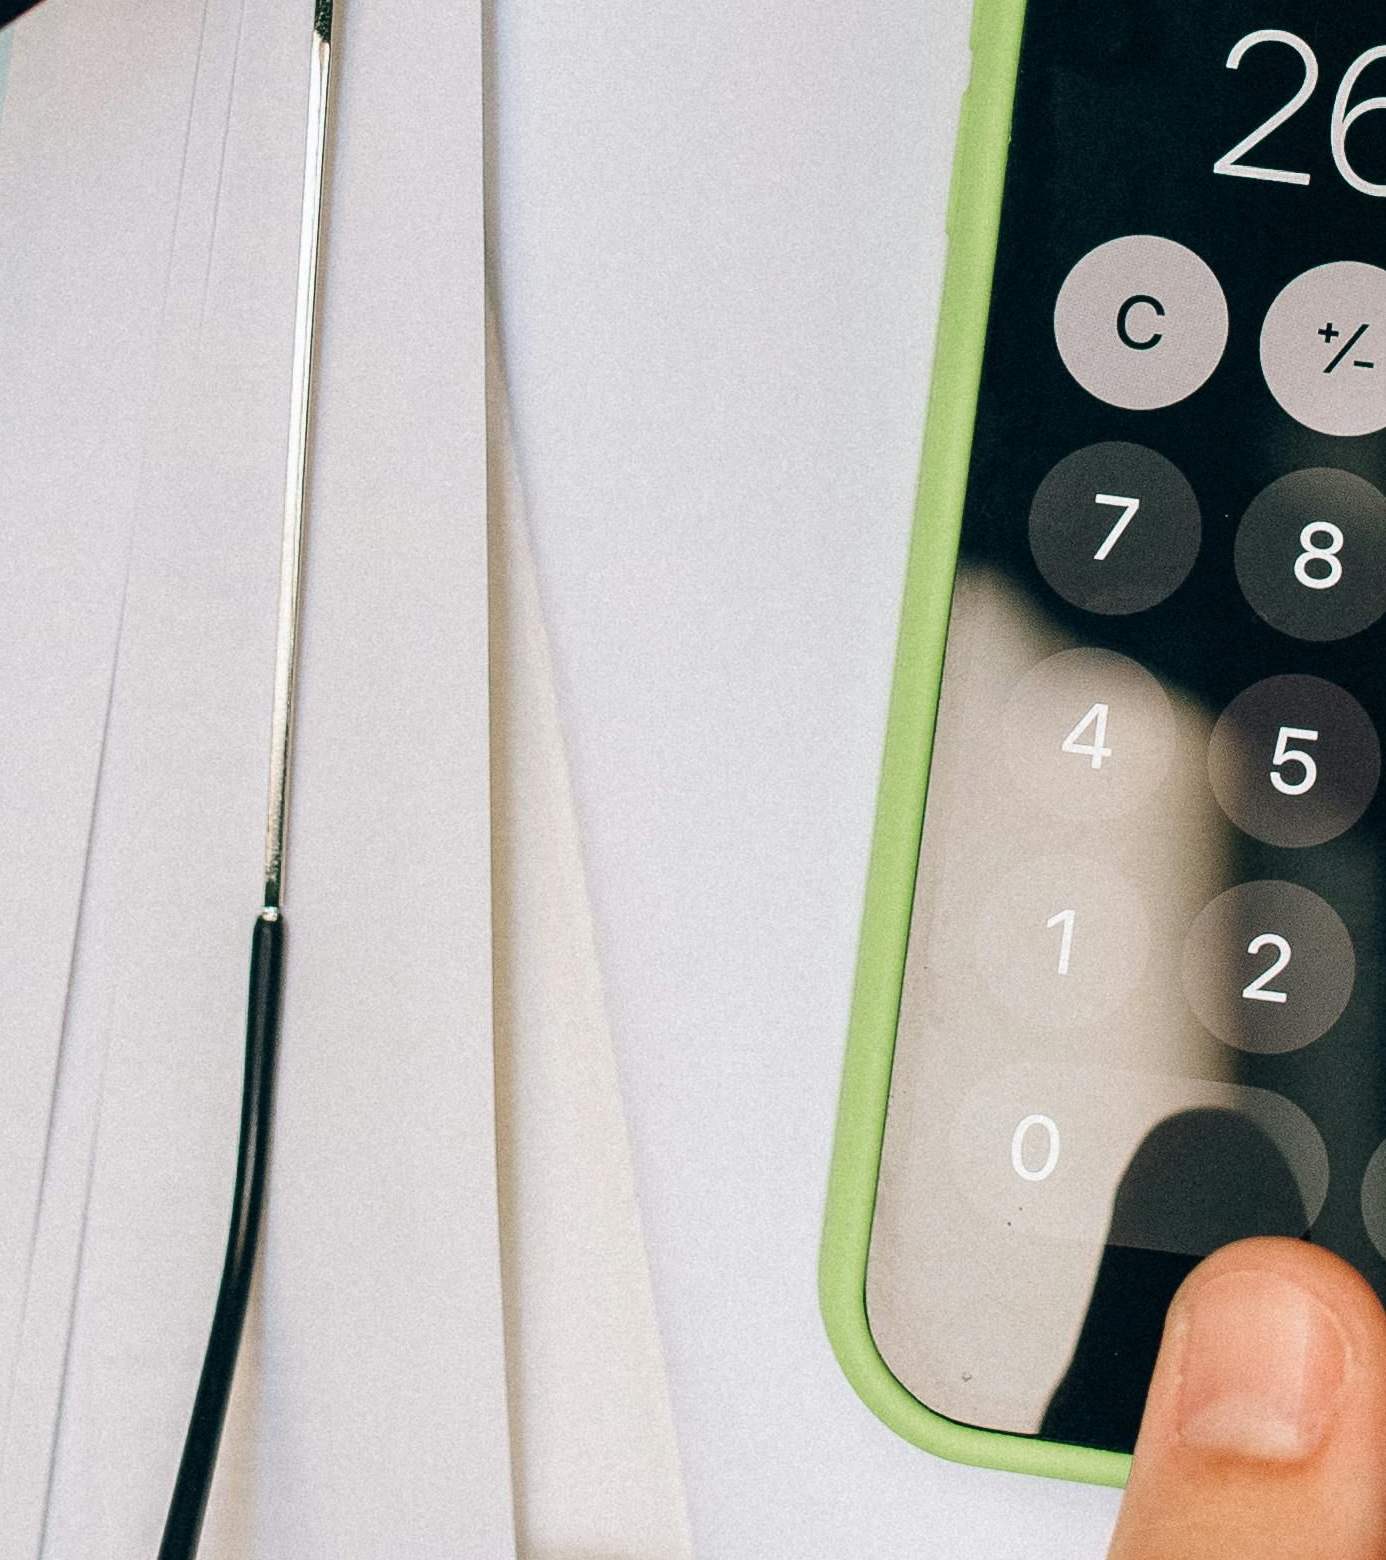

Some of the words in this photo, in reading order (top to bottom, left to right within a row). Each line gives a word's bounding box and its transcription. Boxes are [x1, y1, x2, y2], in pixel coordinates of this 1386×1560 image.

[1115, 294, 1167, 351] C
[1093, 492, 1141, 562] 7
[1292, 520, 1345, 590] 8
[1061, 702, 1112, 770] 4
[1269, 725, 1321, 796] 5
[1045, 908, 1078, 975] 1
[1241, 932, 1293, 1004] 2
[1011, 1113, 1061, 1183] 0
